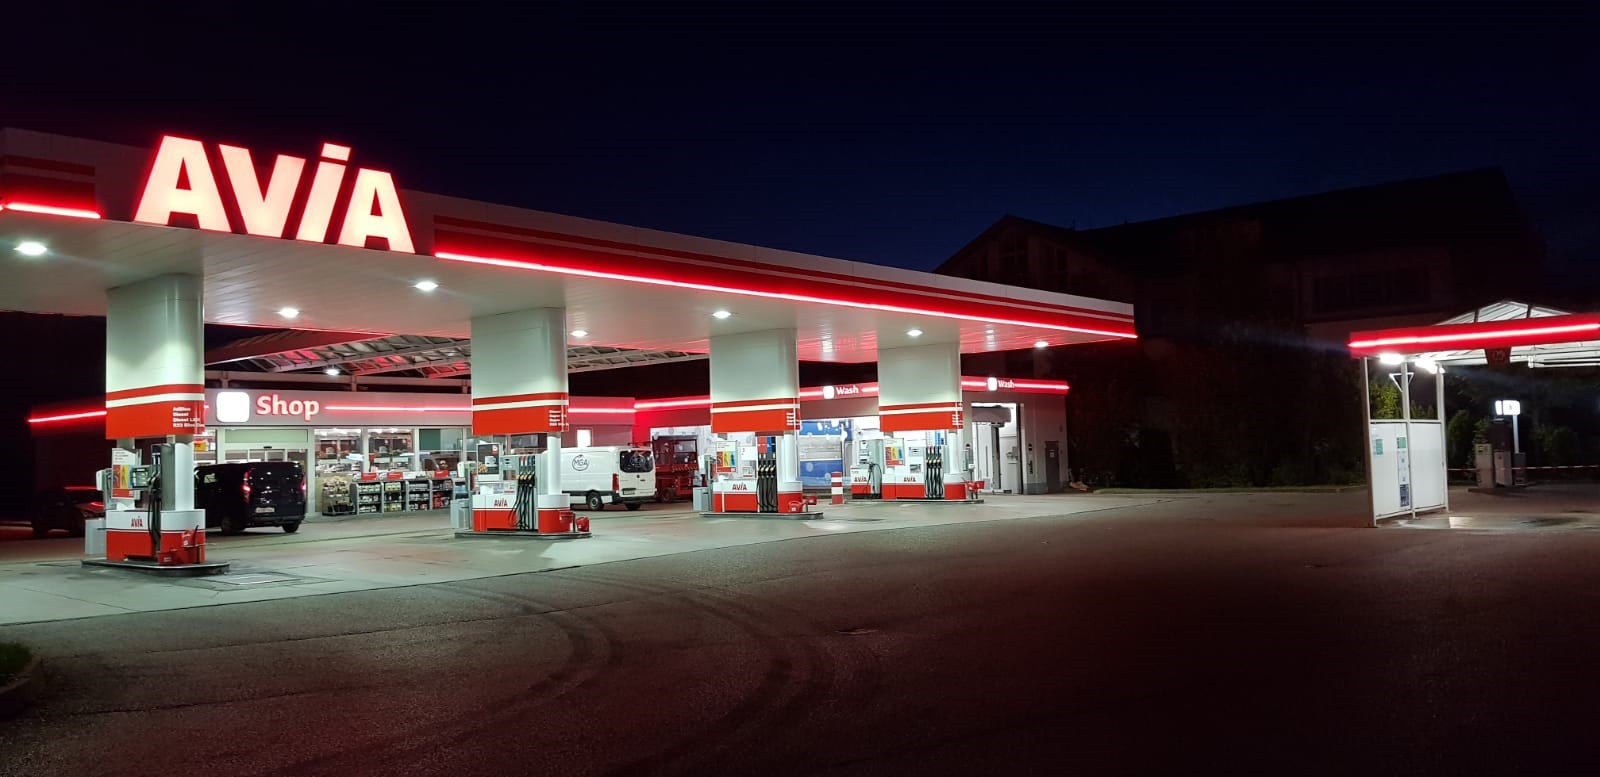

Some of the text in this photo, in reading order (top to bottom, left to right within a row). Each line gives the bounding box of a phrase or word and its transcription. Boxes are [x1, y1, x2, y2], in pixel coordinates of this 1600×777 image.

[998, 379, 1015, 388] Wash
[836, 384, 859, 395] Wash
[256, 394, 320, 421] Shop
